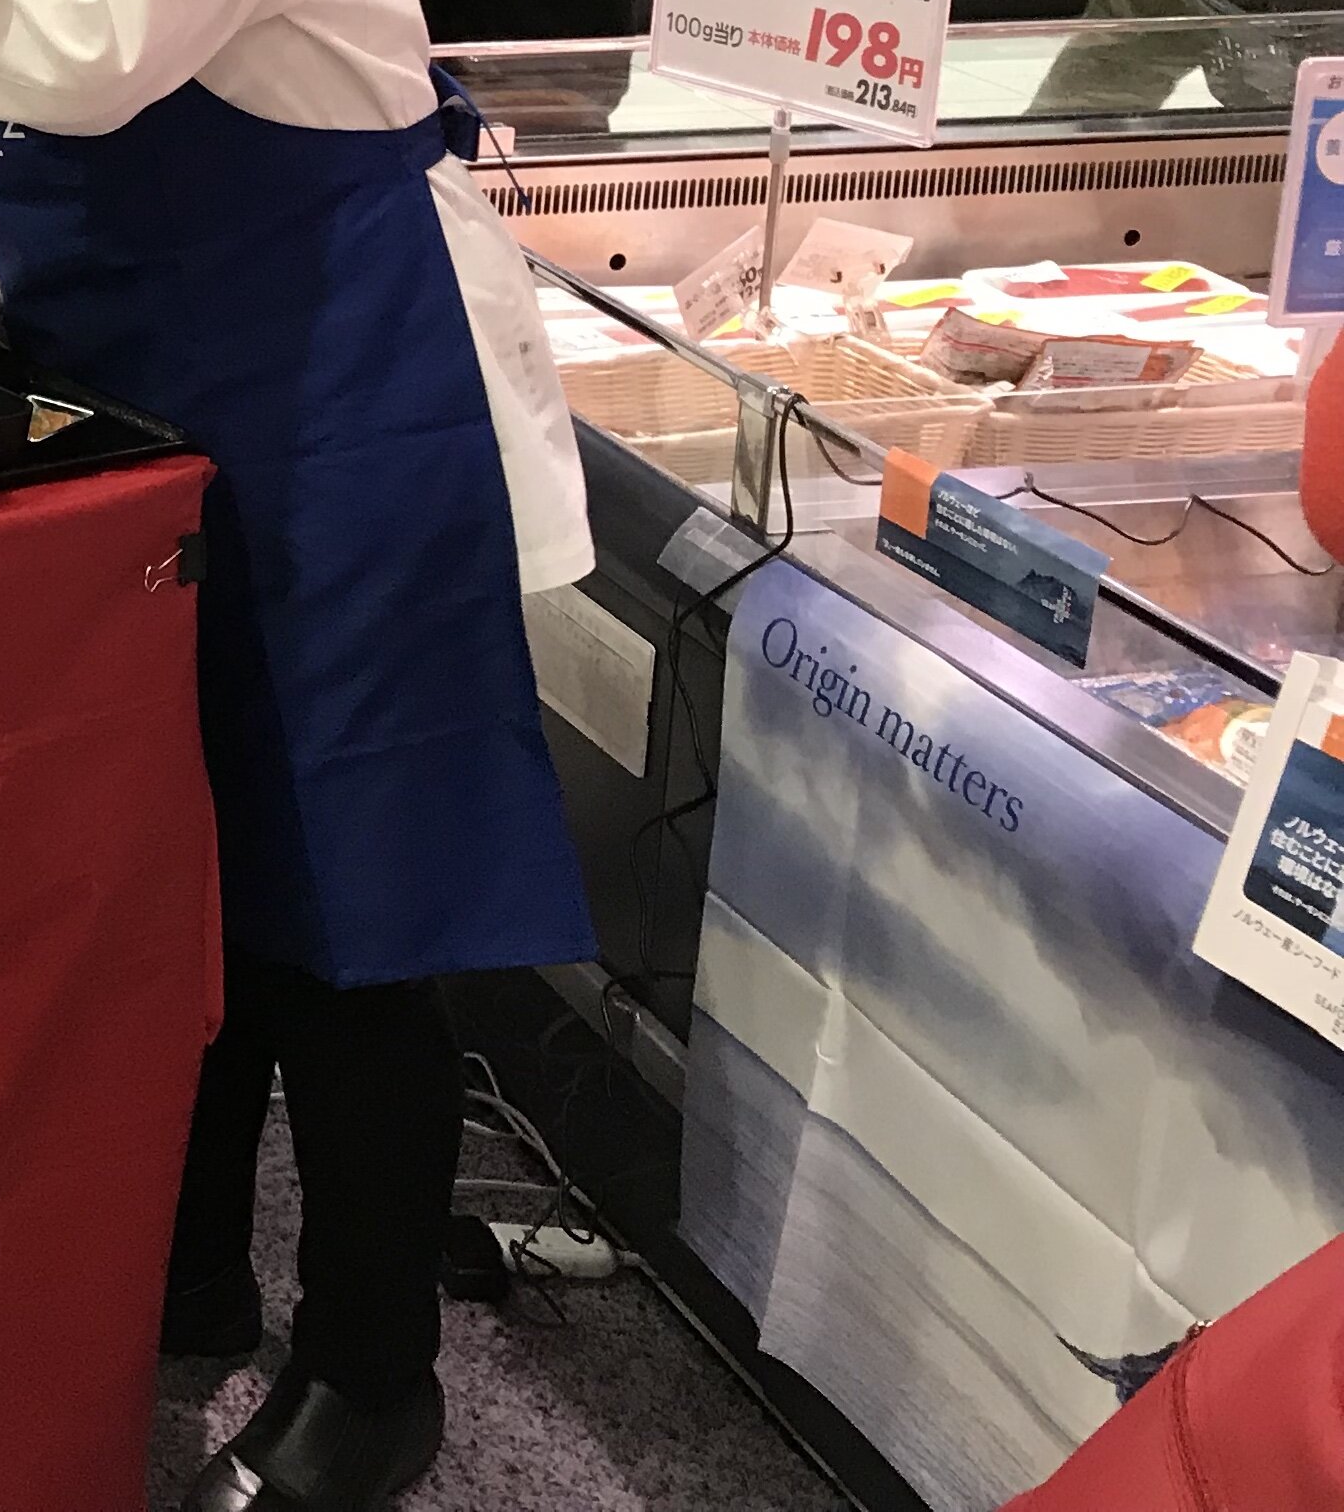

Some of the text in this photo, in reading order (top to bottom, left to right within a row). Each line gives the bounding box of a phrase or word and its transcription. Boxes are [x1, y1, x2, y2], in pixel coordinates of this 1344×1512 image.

[666, 11, 745, 49] 100g当り
[762, 617, 1025, 834] Origin matters
